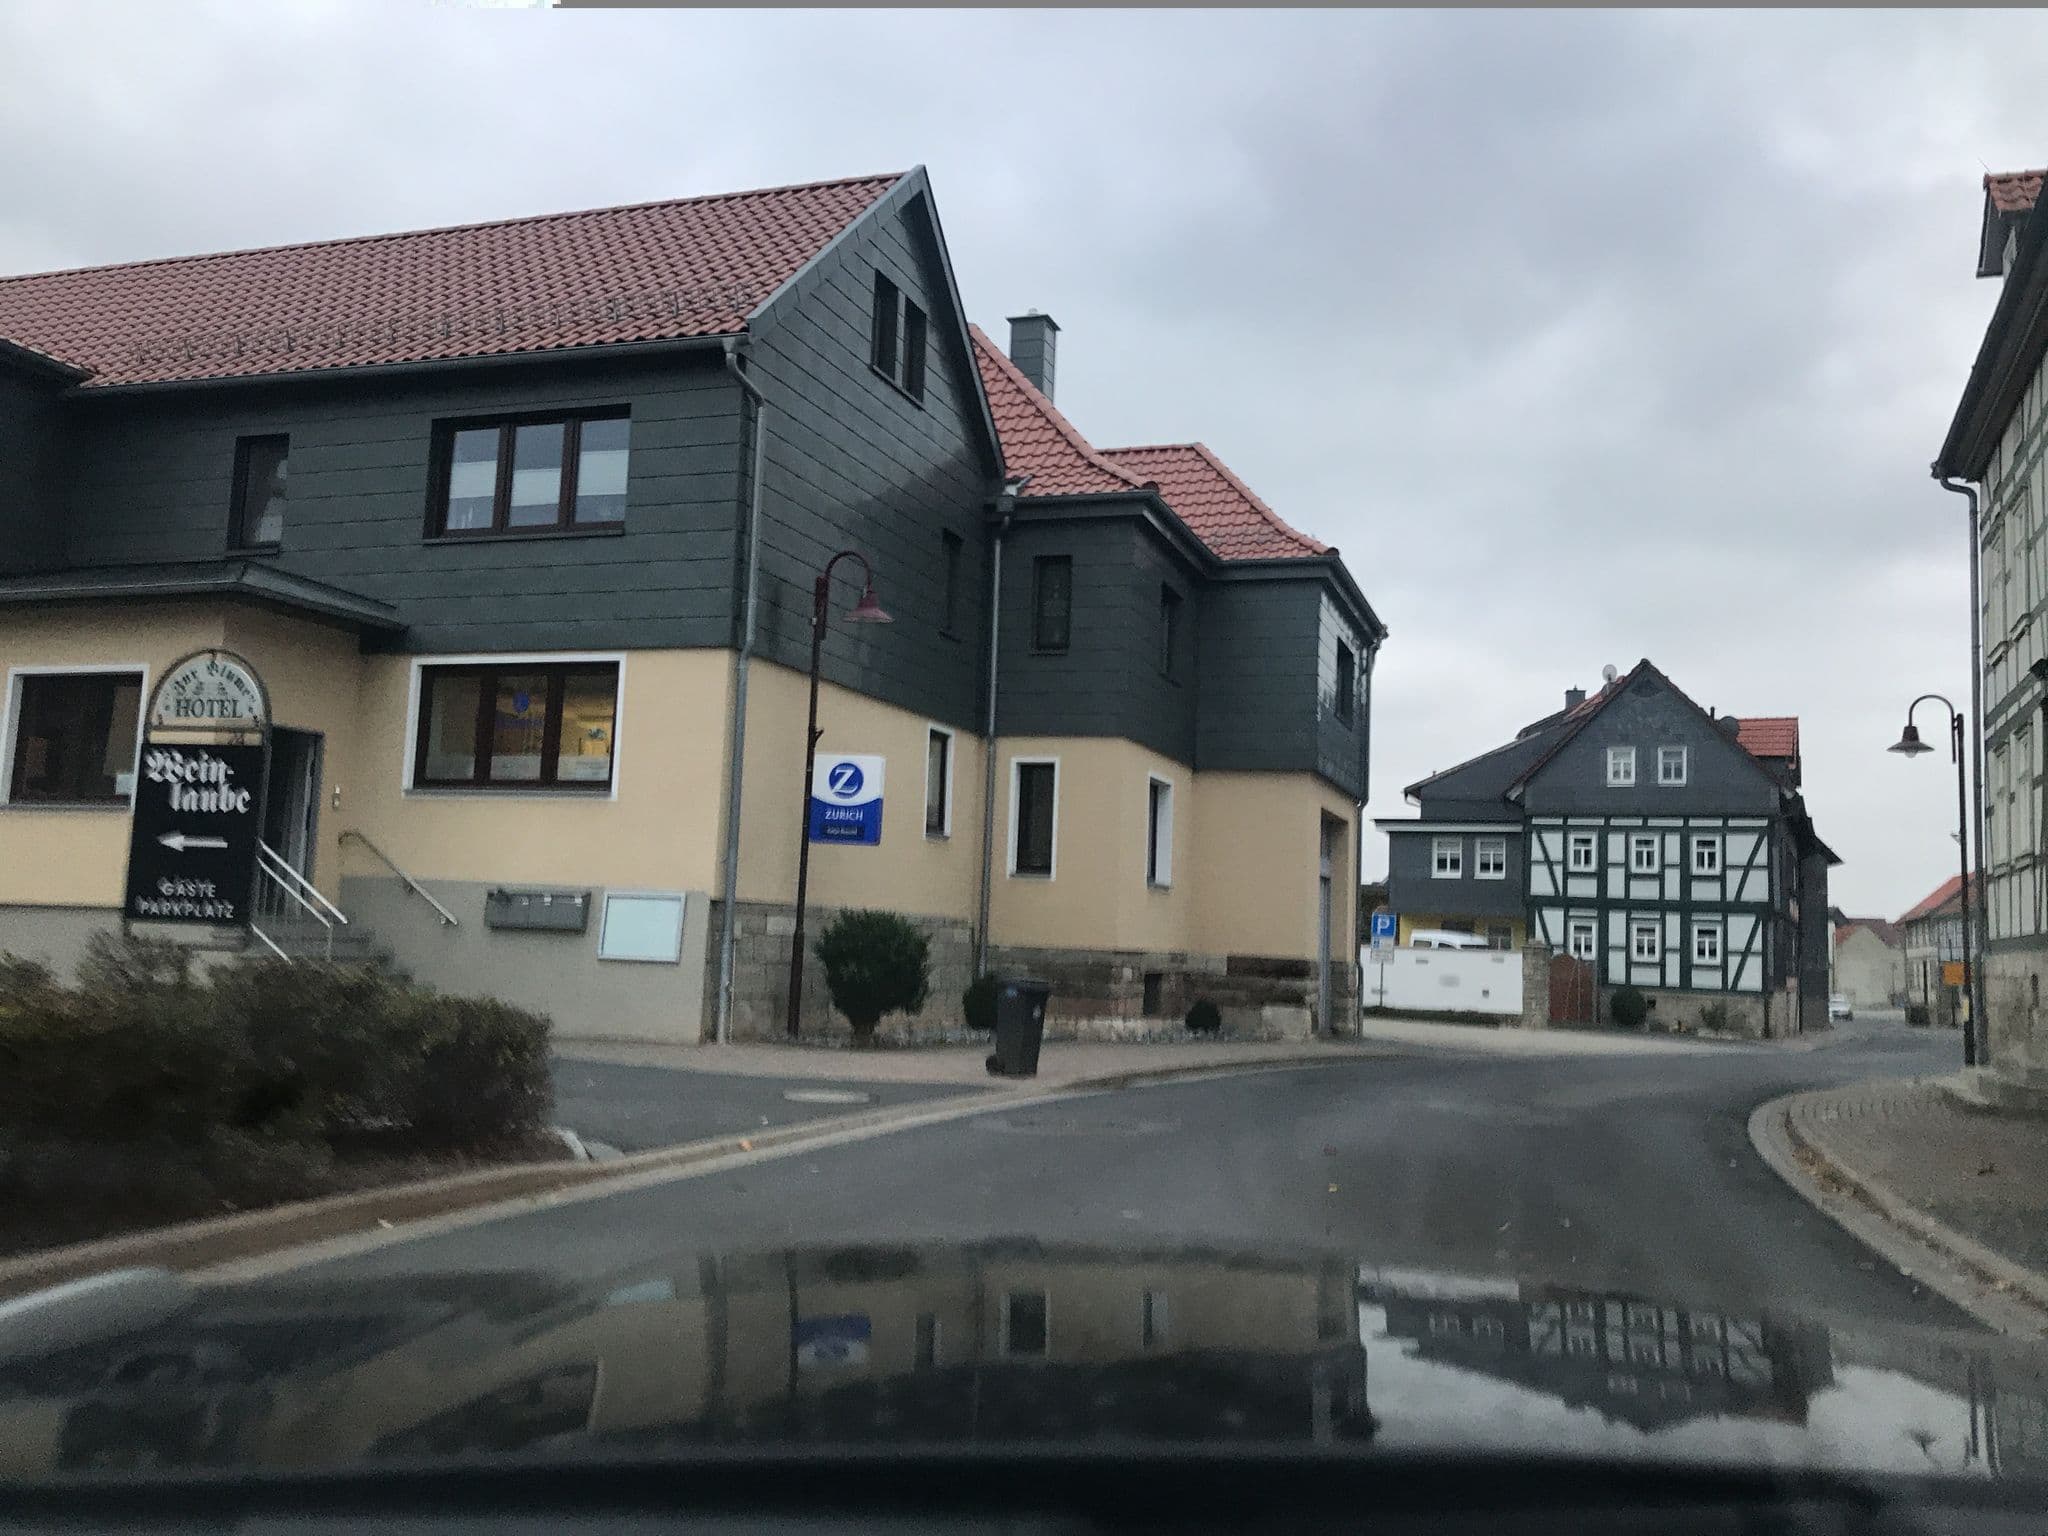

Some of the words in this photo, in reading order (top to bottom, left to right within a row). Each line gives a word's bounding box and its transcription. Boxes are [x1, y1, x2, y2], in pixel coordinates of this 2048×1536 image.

[175, 698, 243, 718] HOTEL
[169, 781, 251, 814] laube
[138, 901, 235, 919] PARKPLATZ
[1377, 915, 1390, 935] P
